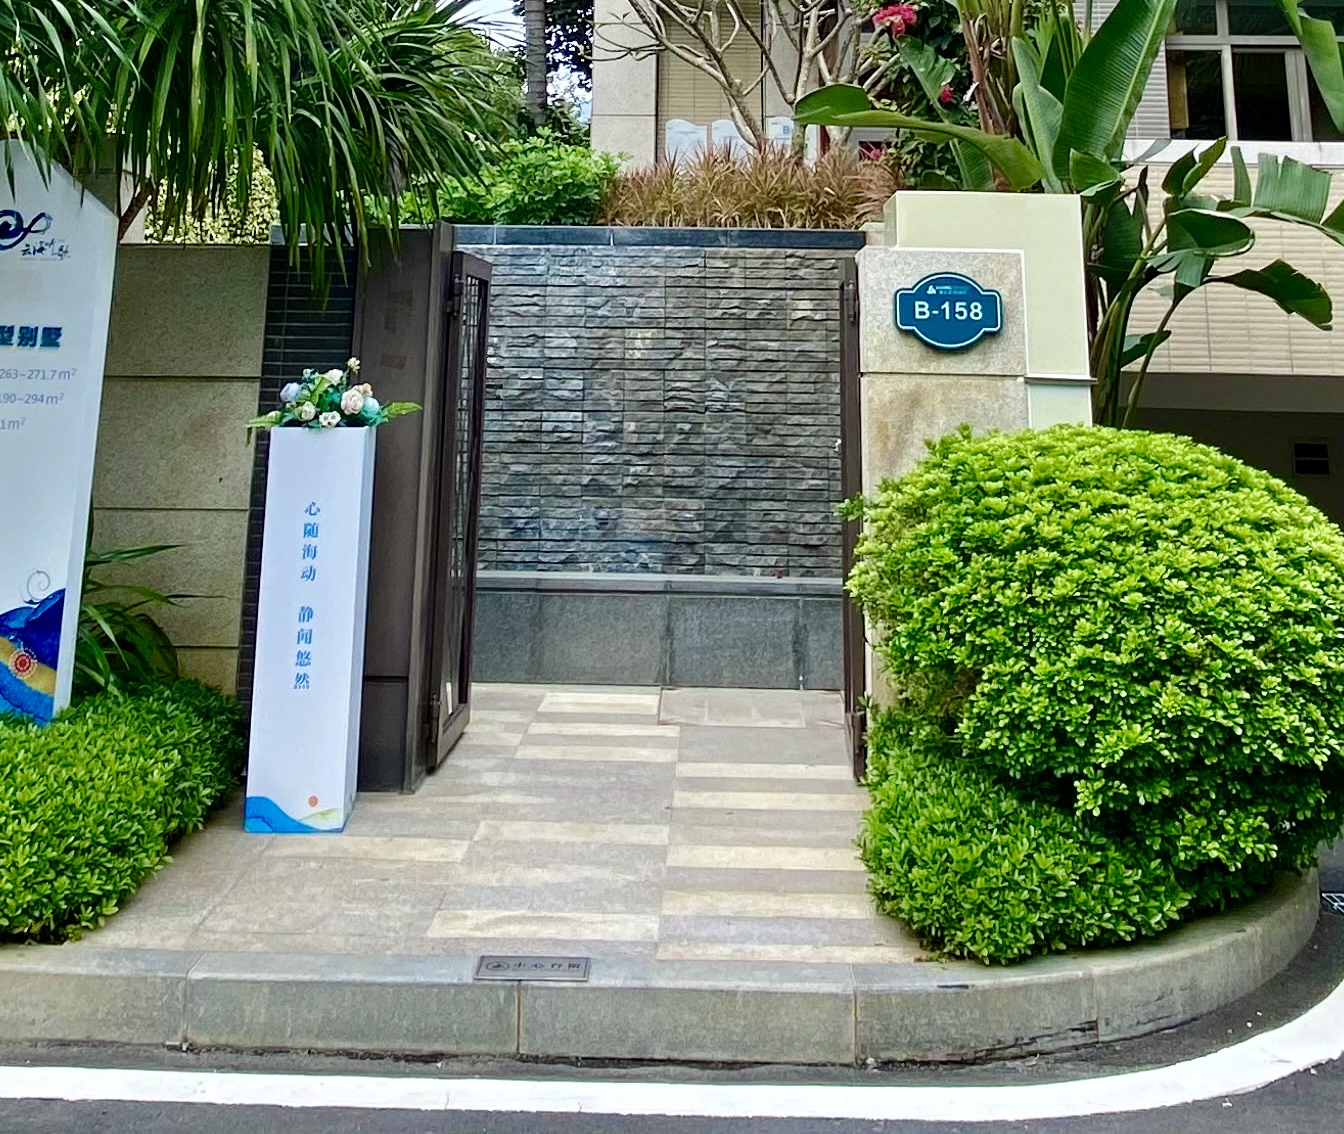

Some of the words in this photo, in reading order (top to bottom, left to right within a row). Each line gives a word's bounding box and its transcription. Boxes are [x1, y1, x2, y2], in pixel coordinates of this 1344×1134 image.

[913, 300, 984, 321] B-158
[299, 500, 321, 583] 心随海动
